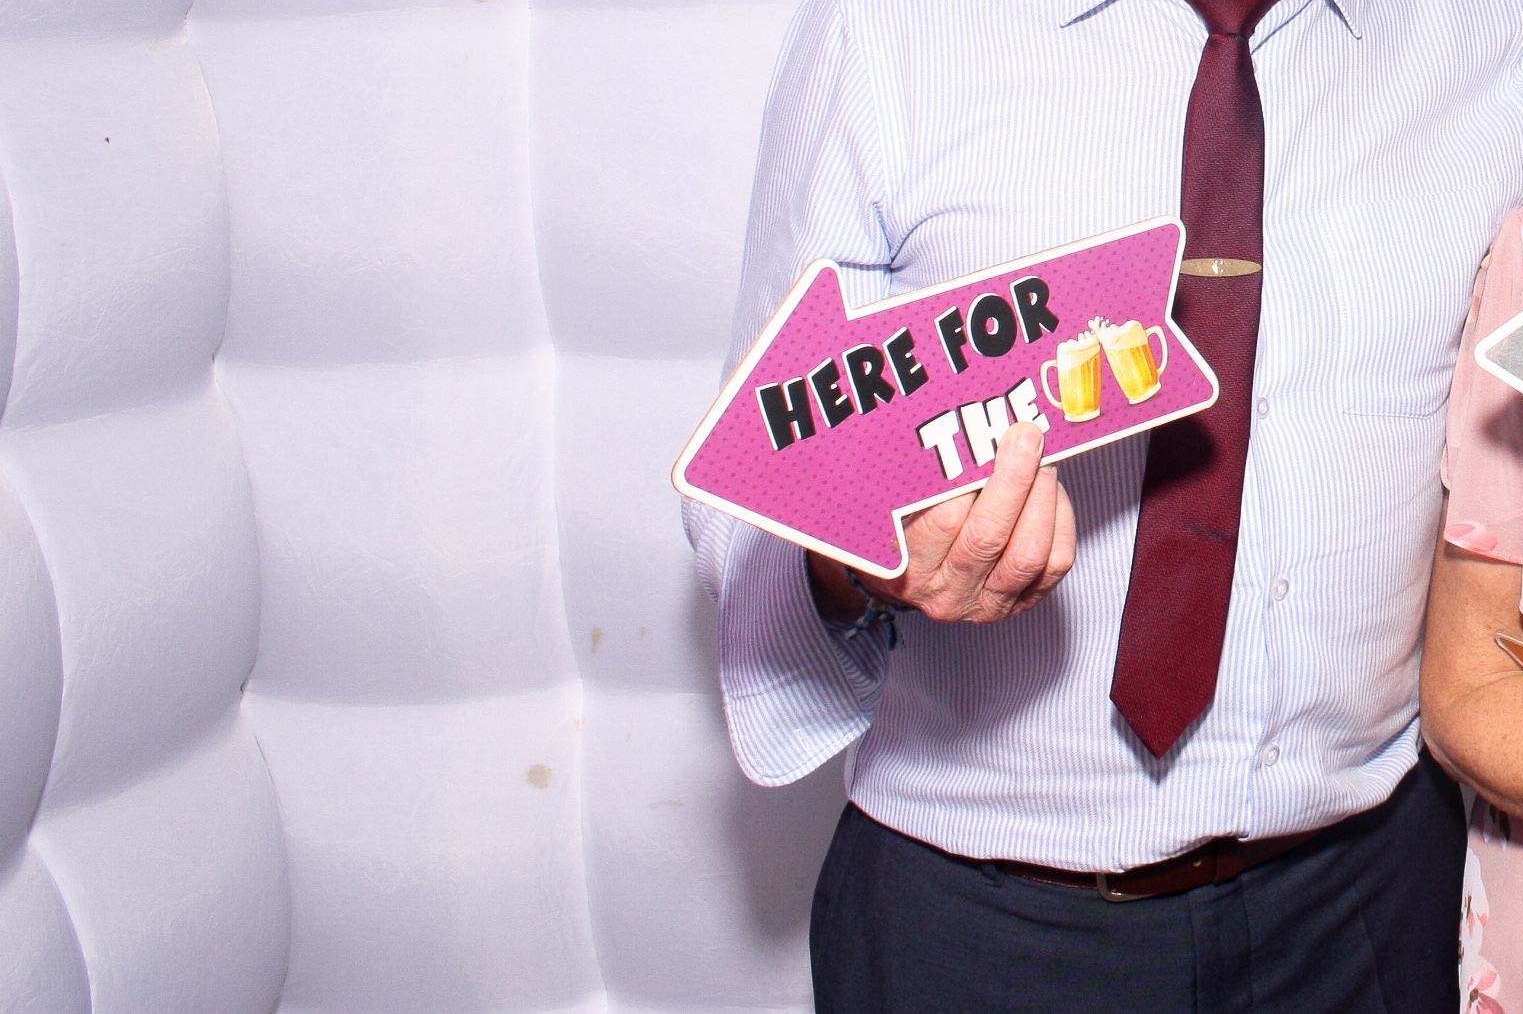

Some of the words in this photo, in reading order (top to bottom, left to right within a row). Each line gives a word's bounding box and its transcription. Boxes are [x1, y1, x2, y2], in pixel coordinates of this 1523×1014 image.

[755, 327, 930, 451] HERE
[934, 275, 1060, 374] FOR
[916, 376, 1051, 480] THE
